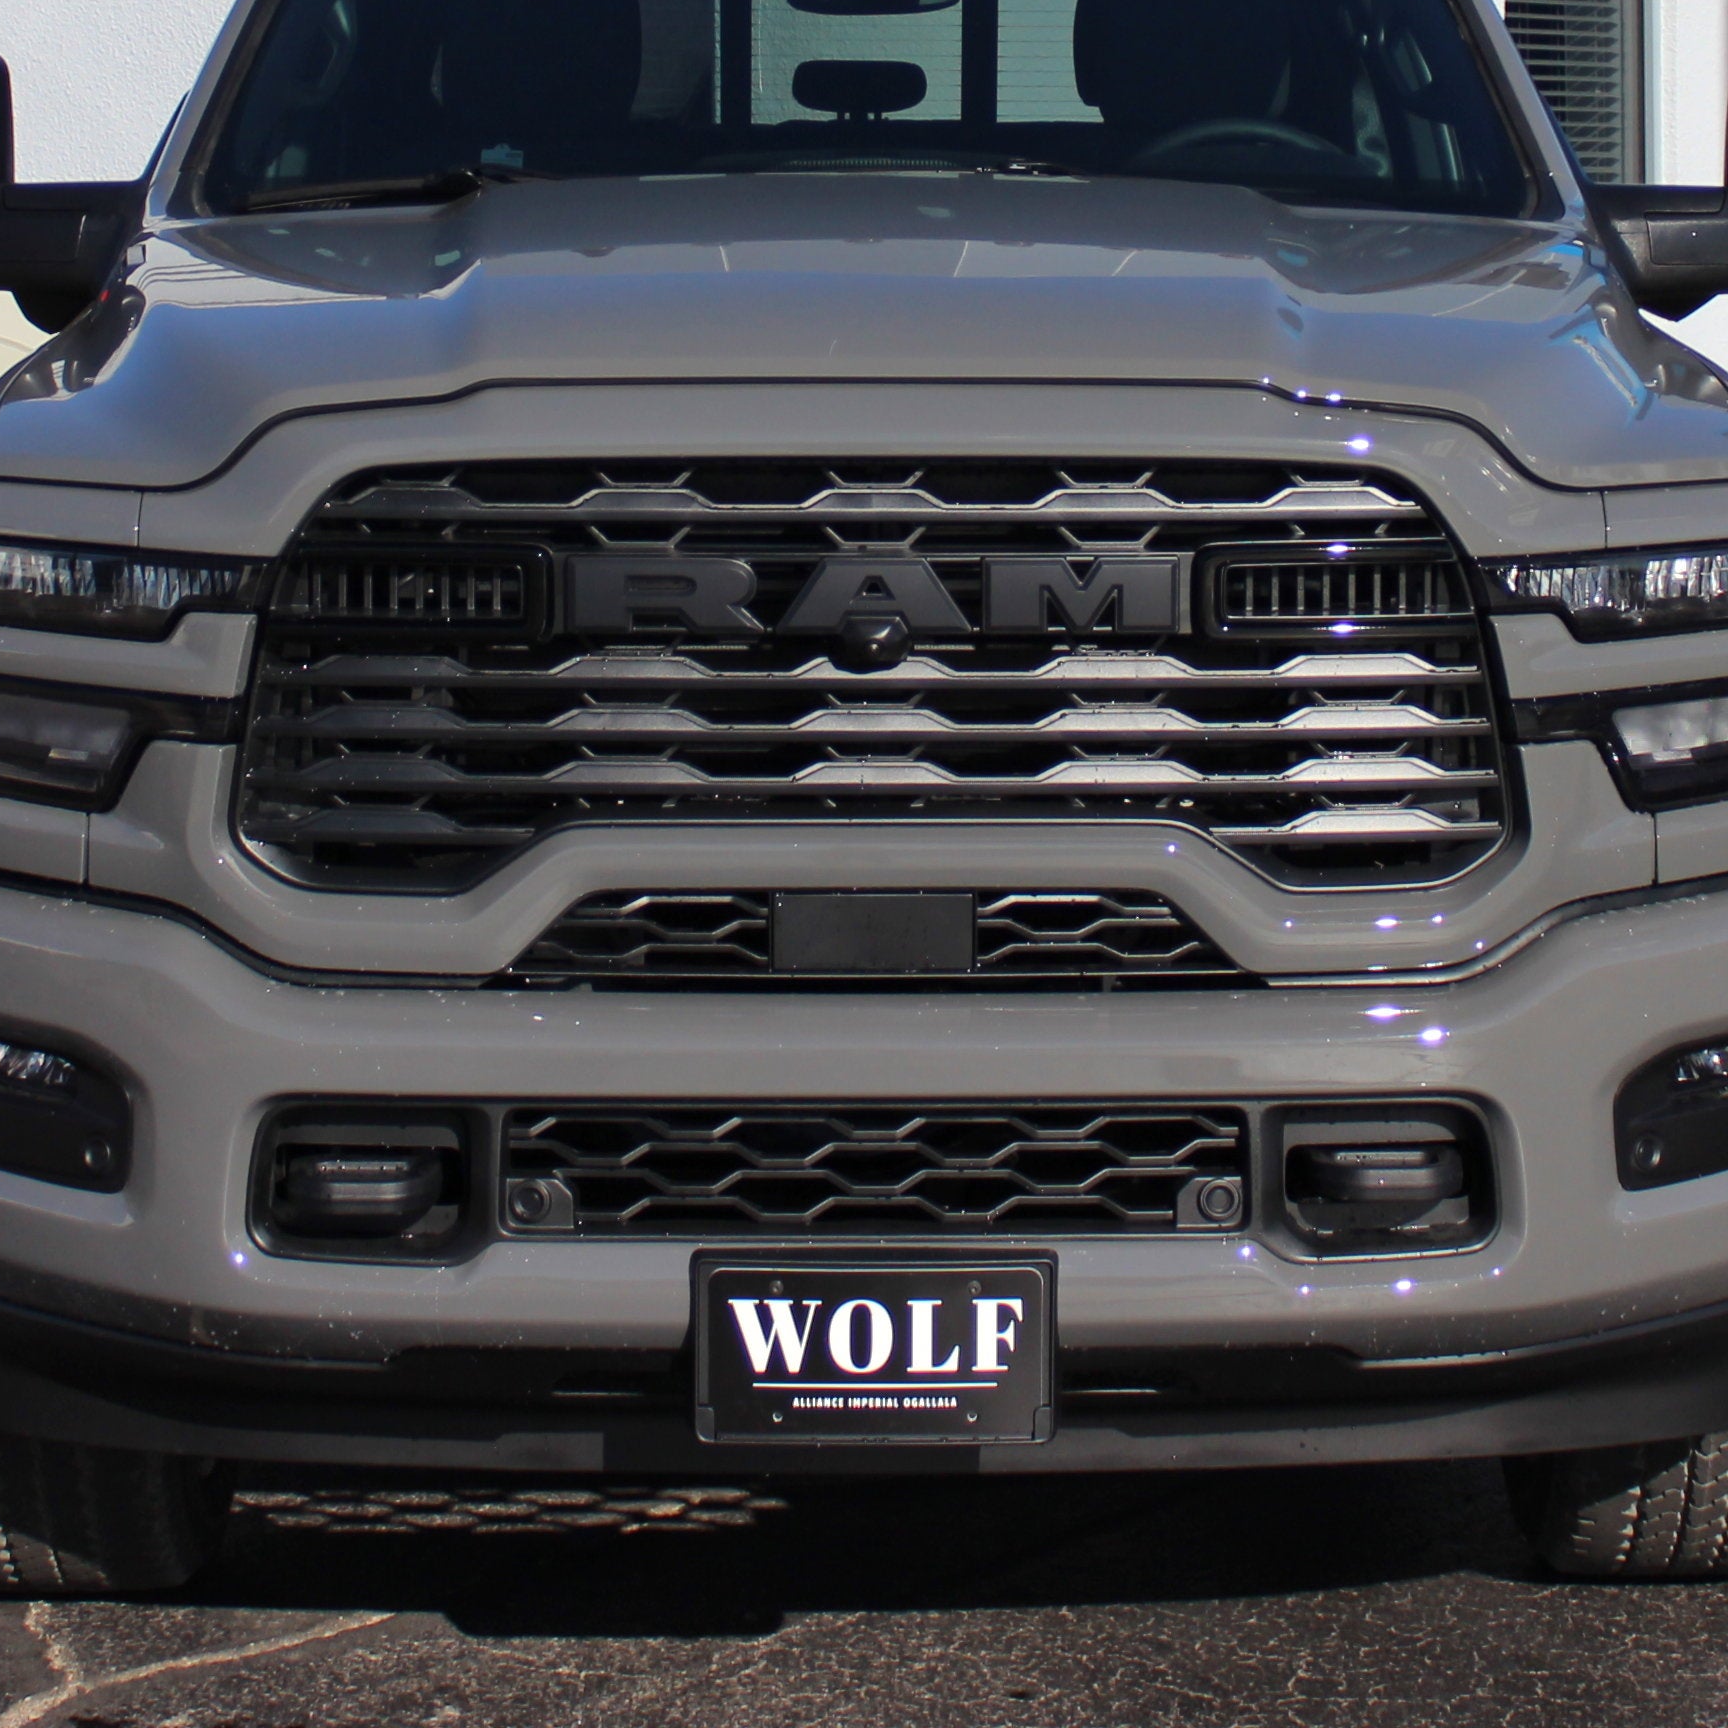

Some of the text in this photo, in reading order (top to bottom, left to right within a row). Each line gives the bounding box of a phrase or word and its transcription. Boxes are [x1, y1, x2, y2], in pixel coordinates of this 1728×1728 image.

[565, 553, 1182, 638] RAM
[727, 1298, 1025, 1374] WOLF
[792, 1396, 958, 1410] ALLIANCE IMPERIAL OGALLALA
